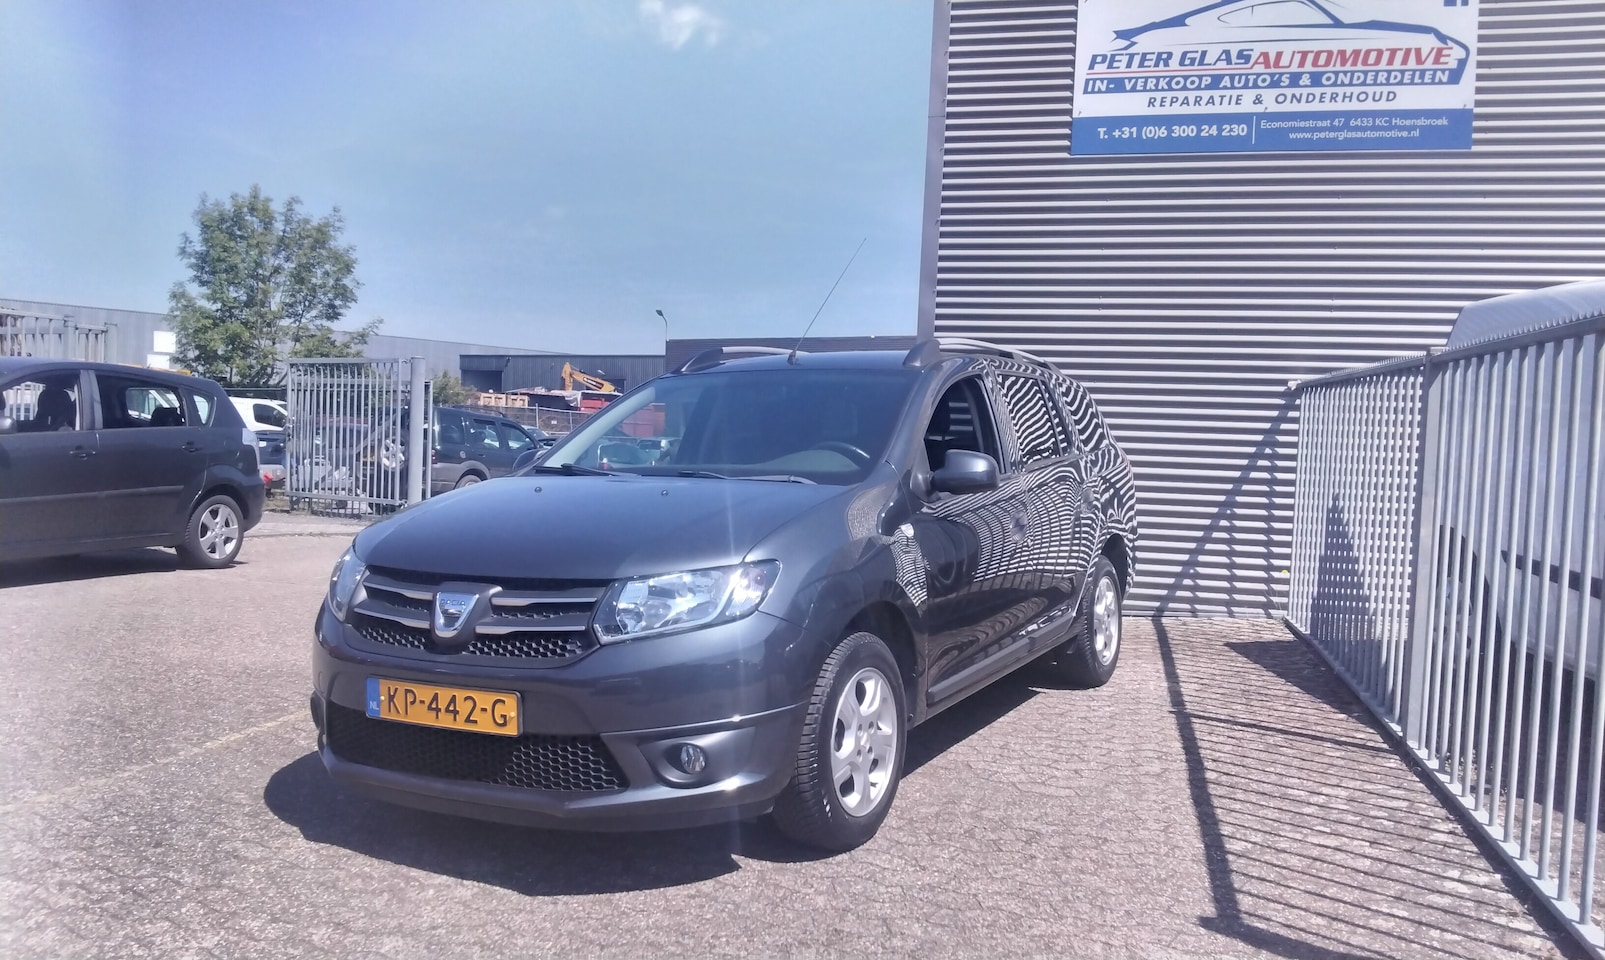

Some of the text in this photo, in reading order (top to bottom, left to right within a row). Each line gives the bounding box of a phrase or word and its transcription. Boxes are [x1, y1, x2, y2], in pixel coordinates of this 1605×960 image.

[1087, 50, 1173, 71] PETER
[1086, 70, 1450, 92] IN- VERKOOP AUTO'S & ONDERDELEN
[1147, 90, 1397, 108] REPARATIE & ONDERHOUD
[1260, 116, 1449, 129] Economiestraat 47 6433 KC Hoensbroek
[1097, 124, 1248, 139] T. +31 (0)6 300 24 230
[1289, 128, 1420, 140] www.peterglasautomotive.nl
[369, 700, 380, 711] NL
[387, 686, 508, 728] KP-442-G
